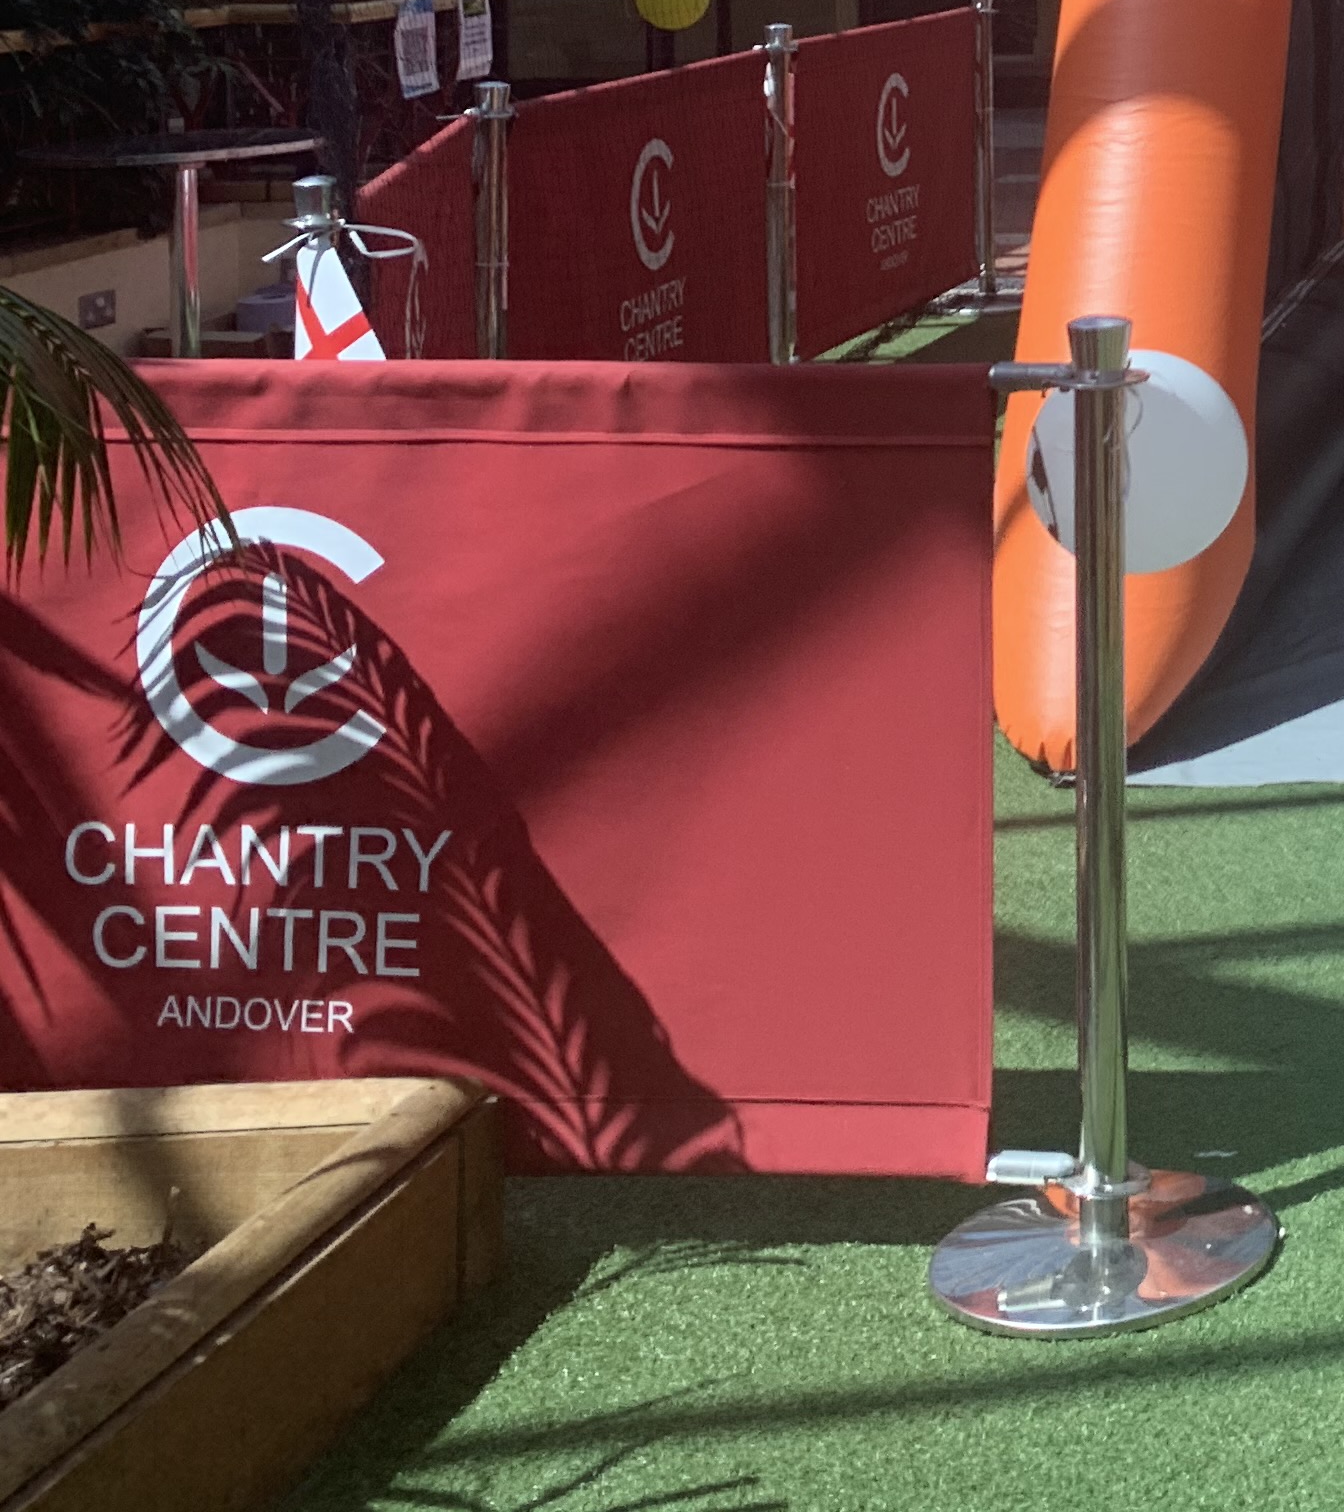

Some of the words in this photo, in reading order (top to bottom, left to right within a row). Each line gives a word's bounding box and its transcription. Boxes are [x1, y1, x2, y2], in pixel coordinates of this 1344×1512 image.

[866, 184, 920, 223] CHANTRY
[871, 215, 918, 253] CENTRE
[620, 276, 687, 332] CHANTRY
[64, 821, 453, 893] CHANTRY
[92, 904, 421, 978] CENTRE
[156, 994, 355, 1034] ANDOVER
